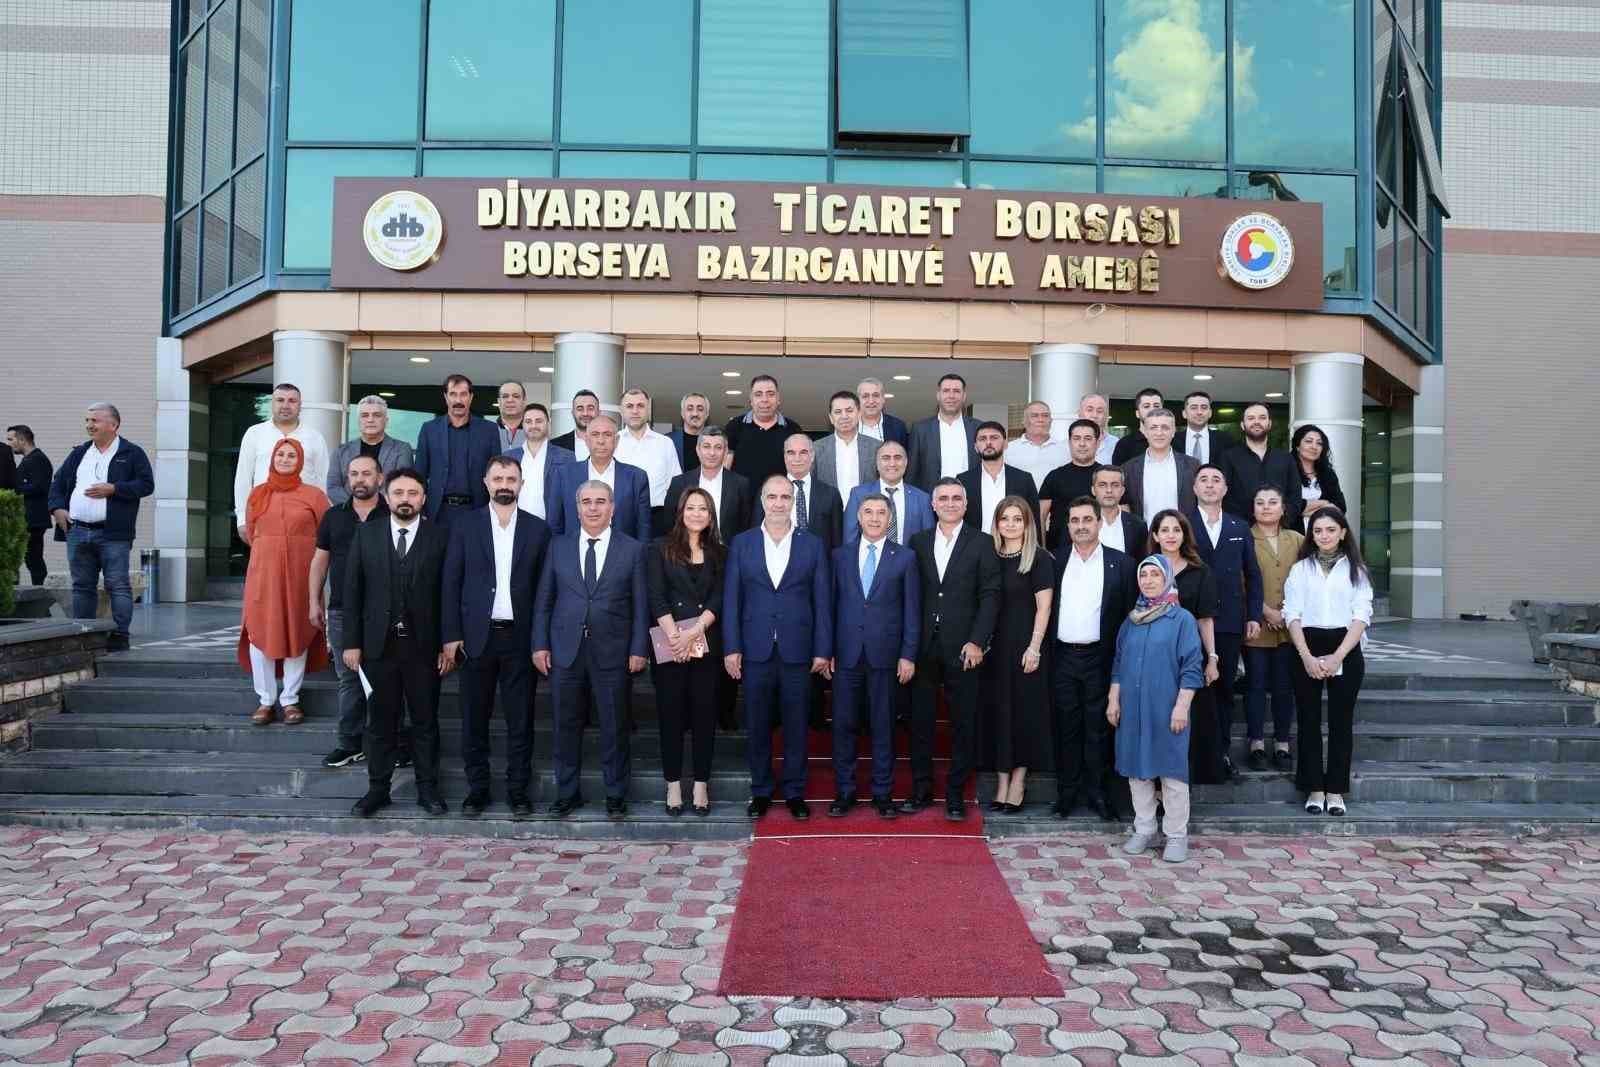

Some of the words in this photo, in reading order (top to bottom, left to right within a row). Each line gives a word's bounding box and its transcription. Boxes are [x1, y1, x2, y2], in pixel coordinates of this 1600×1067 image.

[477, 179, 737, 231] DİYARBAKIR
[773, 186, 960, 235] TİCARET
[995, 199, 1181, 245] BORSASI
[503, 240, 671, 279] BORSEYA
[970, 251, 1015, 287] YA
[1039, 249, 1161, 292] AMEDÊ
